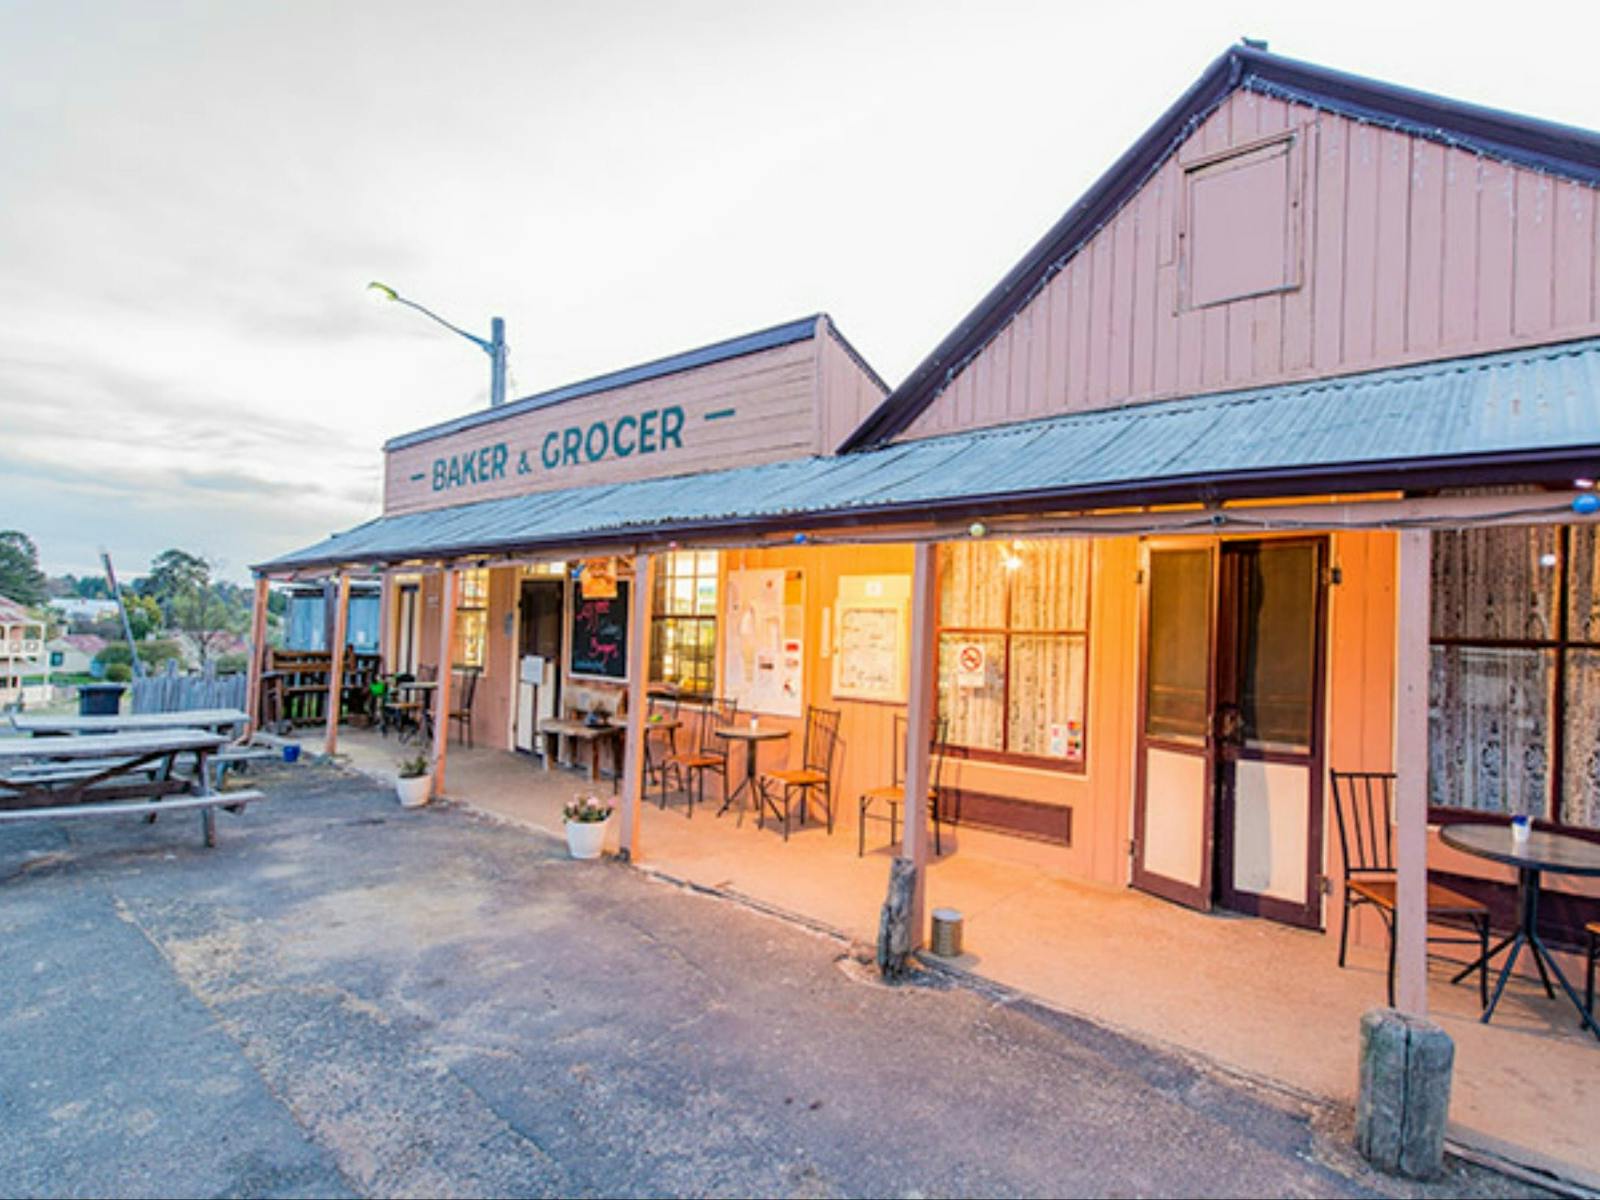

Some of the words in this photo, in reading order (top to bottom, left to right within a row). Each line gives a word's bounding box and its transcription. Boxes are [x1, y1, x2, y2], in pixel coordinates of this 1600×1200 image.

[432, 442, 508, 491] BAKER
[517, 450, 532, 475] &
[541, 405, 685, 469] GROCER
